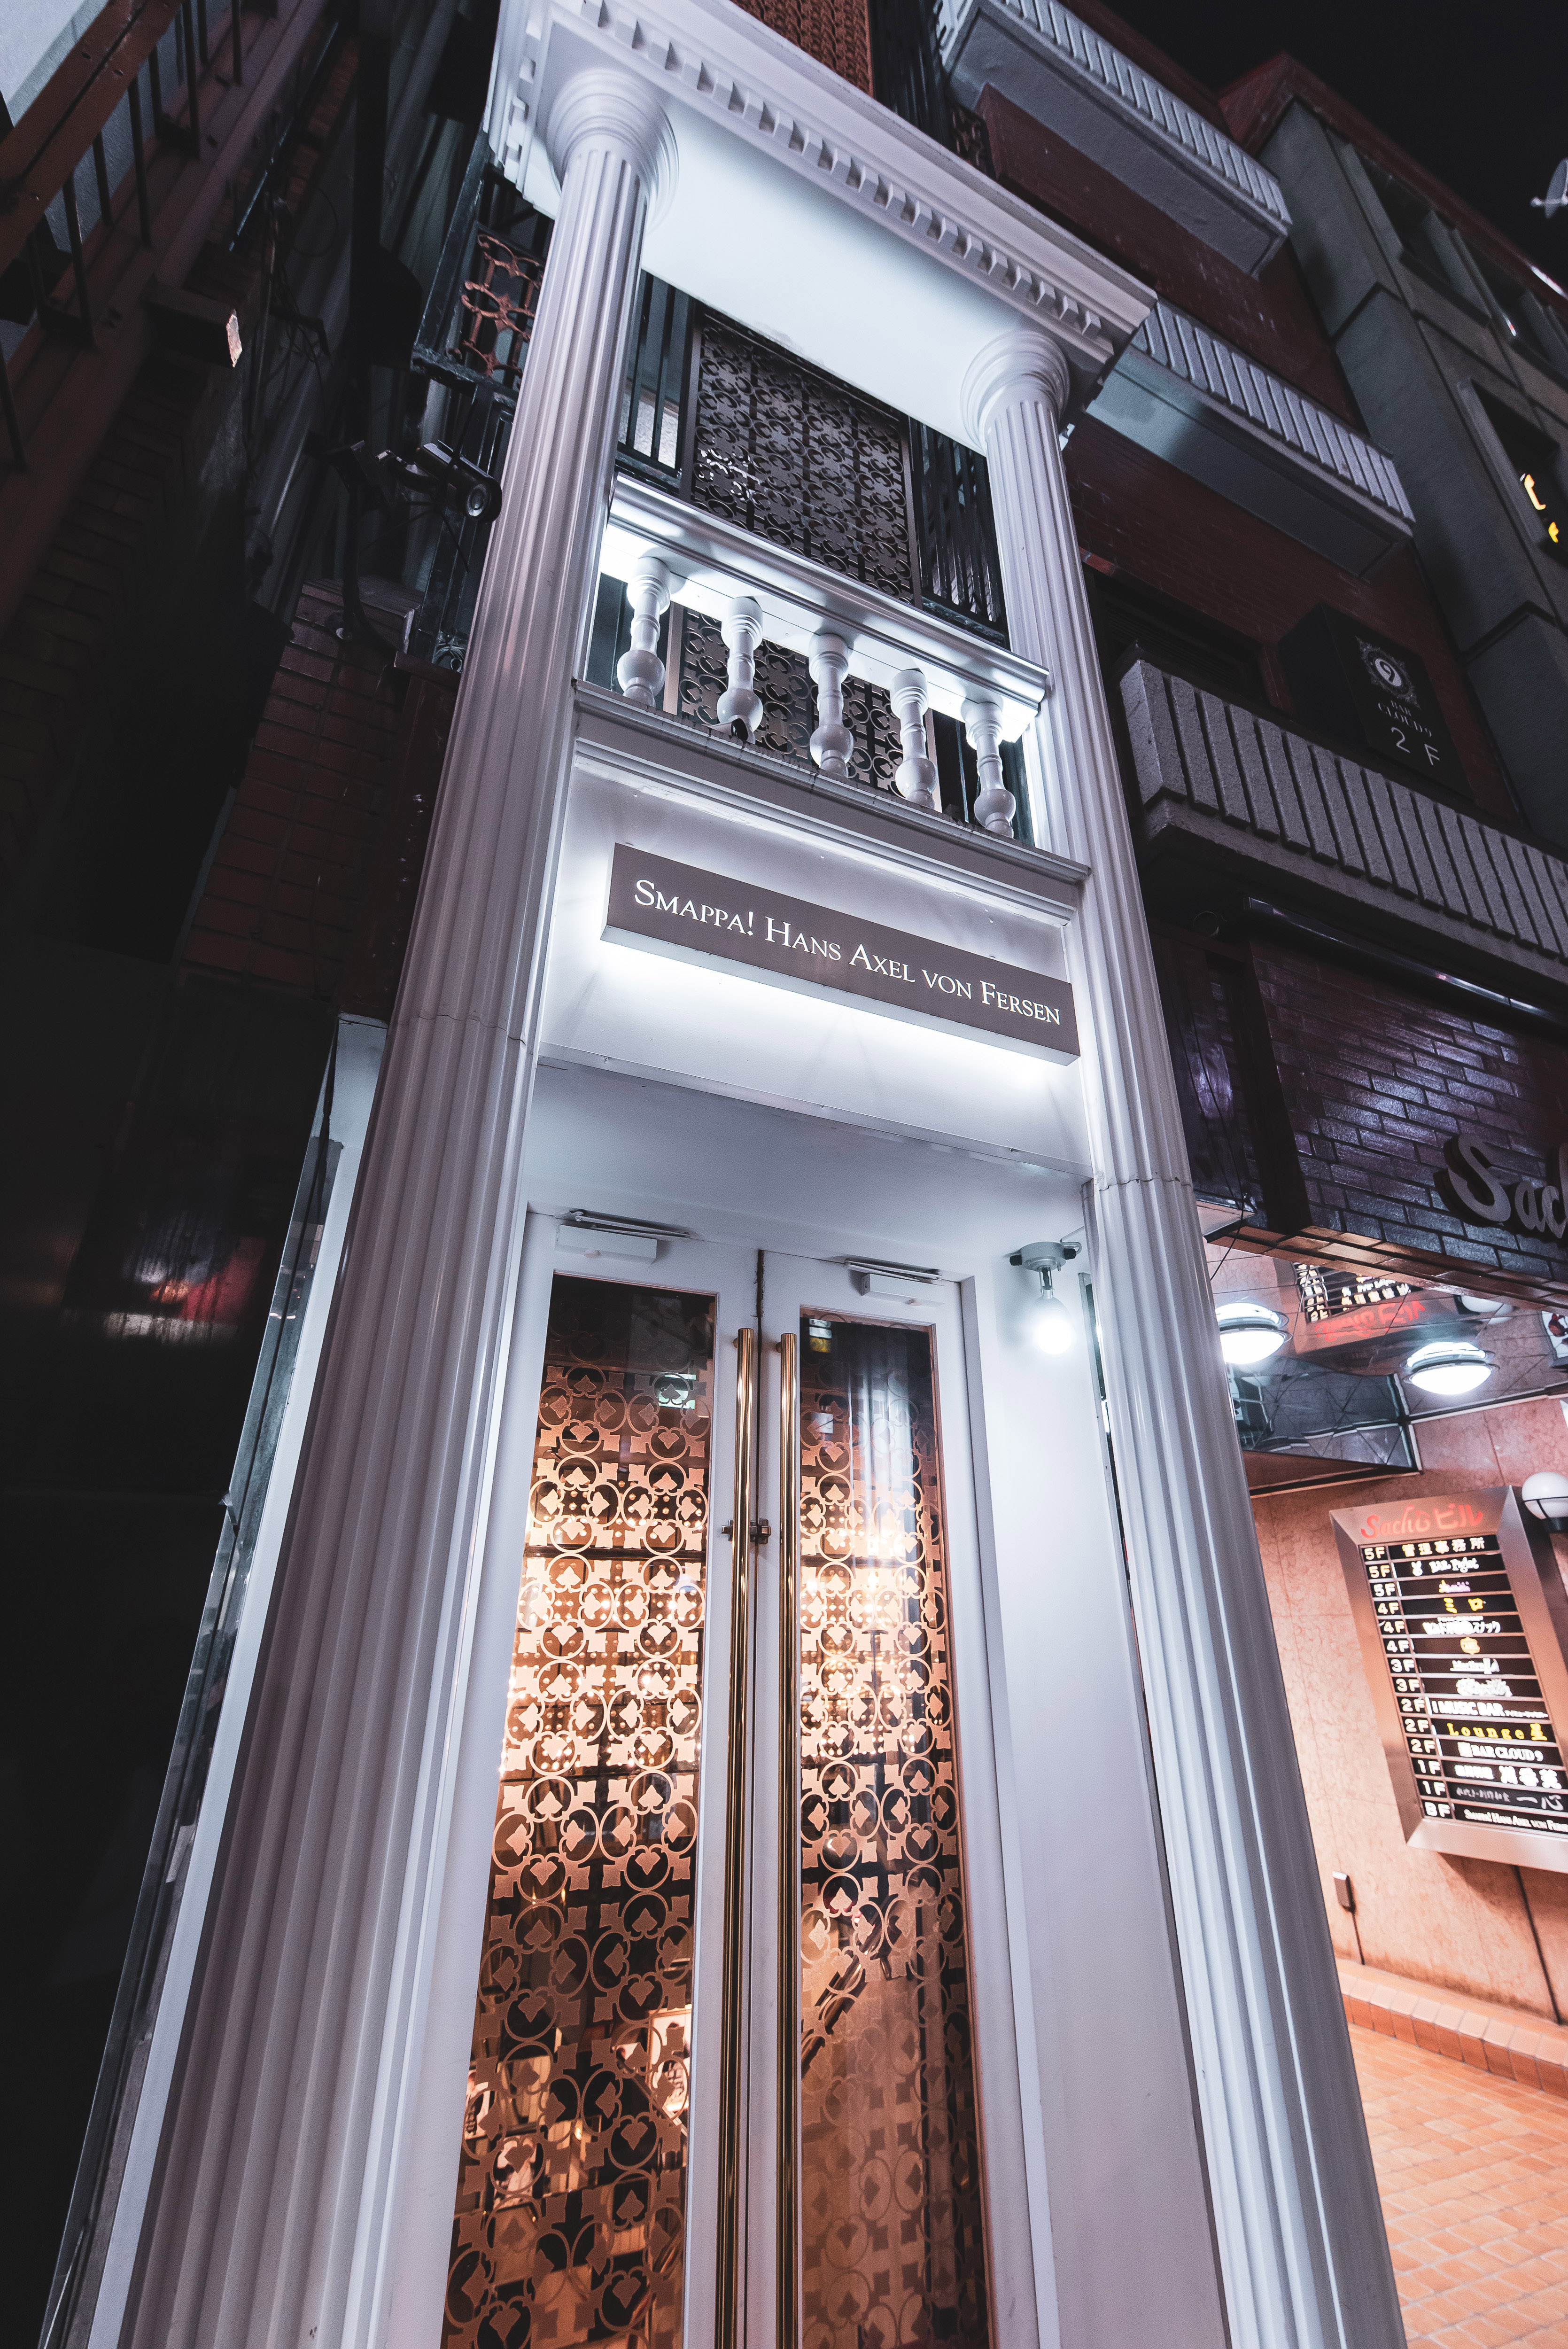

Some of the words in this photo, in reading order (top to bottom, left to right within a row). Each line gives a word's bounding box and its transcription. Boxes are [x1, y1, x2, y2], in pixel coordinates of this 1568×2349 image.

[1390, 700, 1411, 716] BAR
[1448, 1135, 1568, 1238] Sac
[1364, 1546, 1385, 1560] 5F
[1402, 1537, 1485, 1557] 管理事務所
[1369, 1565, 1390, 1579] 5F
[1374, 1583, 1395, 1597] 5F
[1378, 1602, 1399, 1615] 4F
[1383, 1621, 1405, 1633] 4F
[1387, 1640, 1409, 1653] 4F
[1390, 1659, 1415, 1672] 3F
[1396, 1678, 1420, 1692] 3F
[1401, 1698, 1425, 1712] 2F
[1438, 1700, 1478, 1715] MUSIC
[1477, 1702, 1506, 1717] BAR
[1405, 1719, 1429, 1733] 2F
[1411, 1739, 1436, 1753] 2F
[1471, 1744, 1496, 1758] BAR
[1417, 1759, 1440, 1774] 1F
[1422, 1781, 1445, 1796] 1F
[1424, 1802, 1450, 1817] BF
